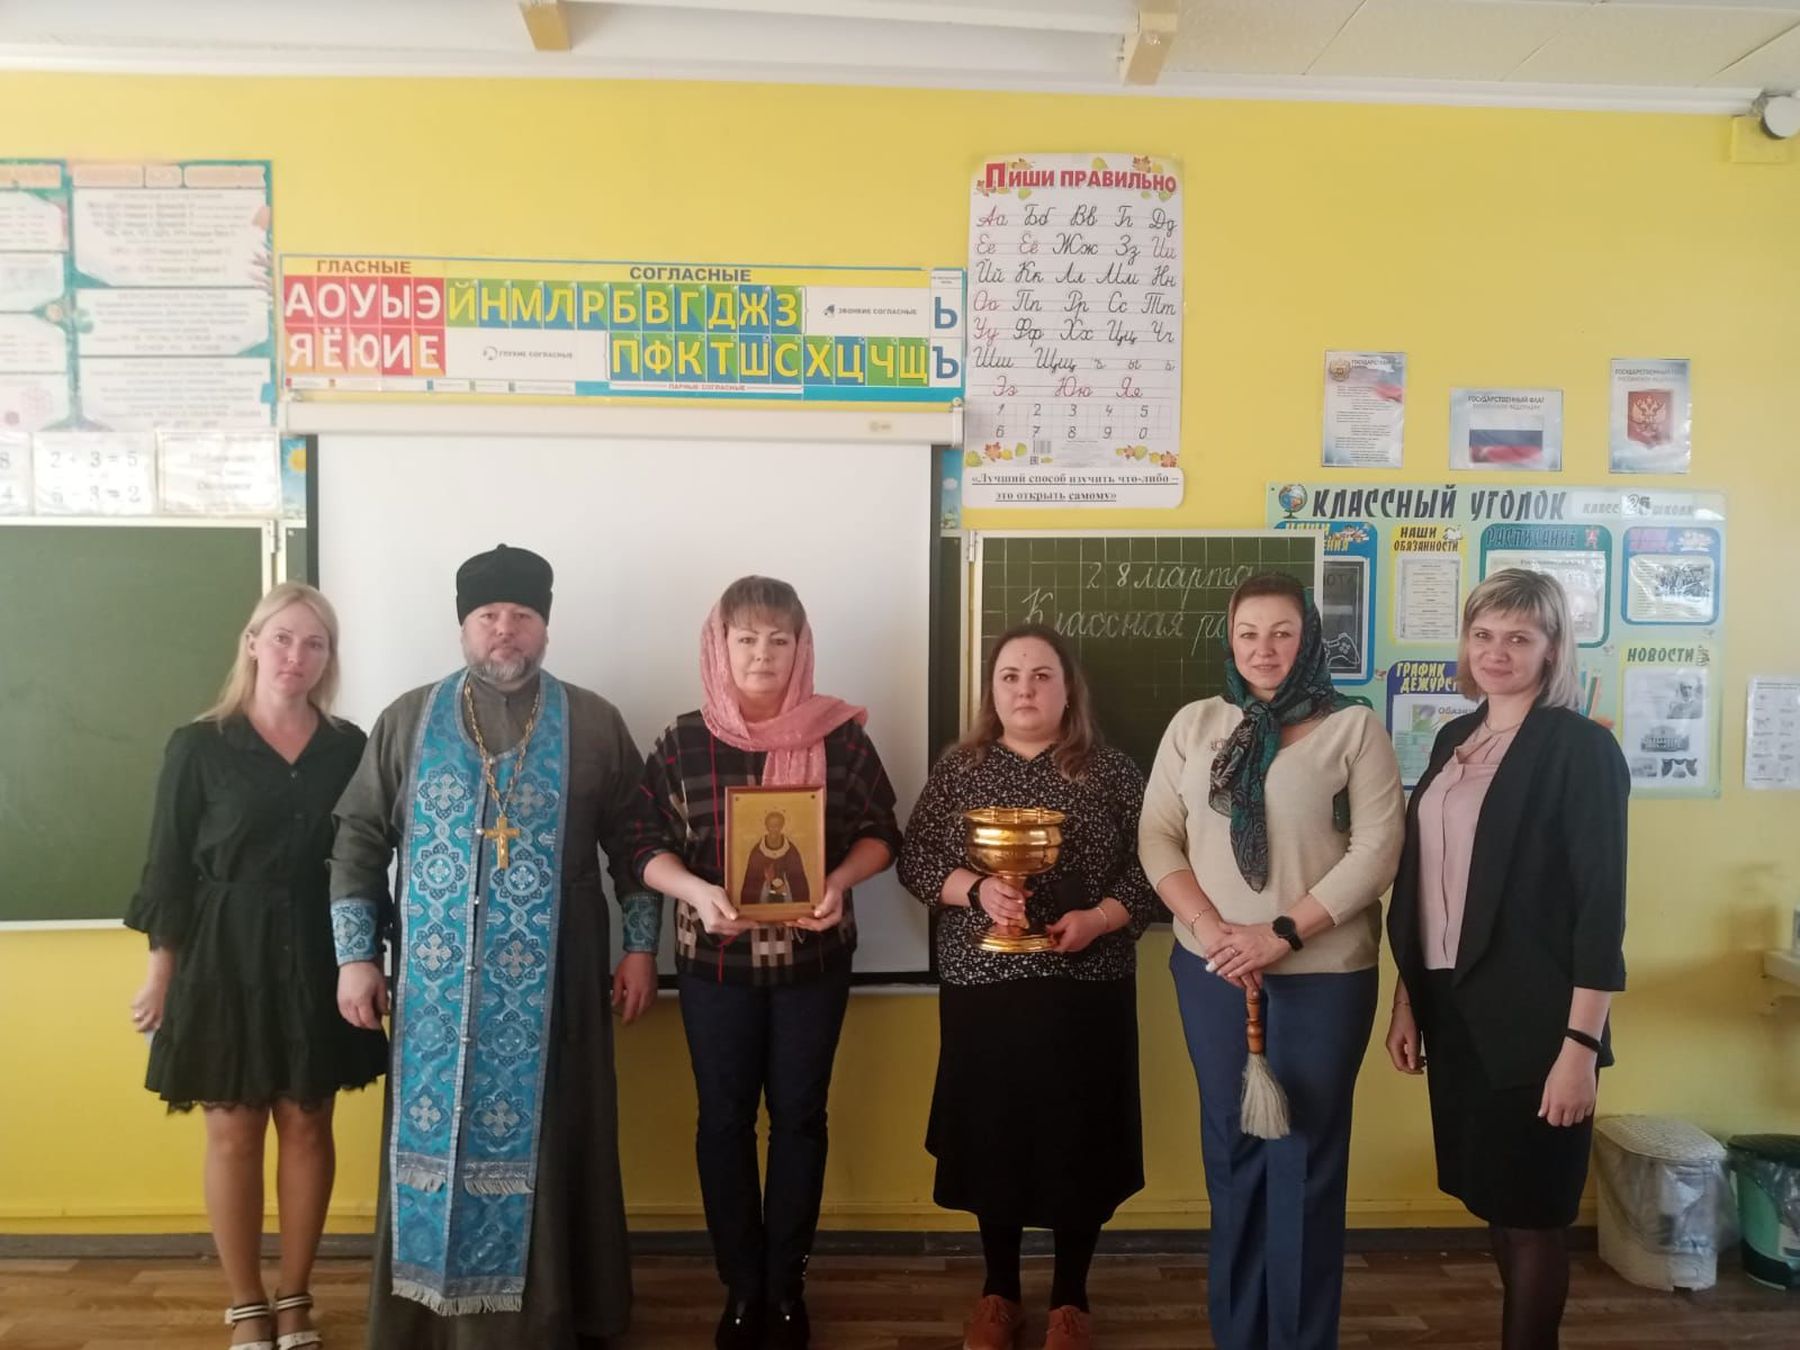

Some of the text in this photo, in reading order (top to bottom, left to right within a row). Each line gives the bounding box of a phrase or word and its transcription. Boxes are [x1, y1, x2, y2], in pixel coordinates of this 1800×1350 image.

[1060, 170, 1177, 193] ПРАВИЛЬНО
[976, 204, 1008, 227] Аа
[1024, 203, 1056, 226] Бб
[1070, 203, 1098, 227] Вв
[1148, 208, 1177, 237] Дд
[976, 233, 996, 255] Ее
[1052, 232, 1098, 256] Жж
[1115, 234, 1140, 265] Зз
[1152, 236, 1177, 260] Ии
[317, 259, 412, 275] ГЛАСНЫЕ
[630, 265, 752, 282] СОГЛАСНЫЕ
[976, 258, 1177, 287] Йй Кк Лл Мм Нн
[973, 289, 1177, 320] Оо Пп Рр Сс Тт
[973, 316, 1176, 348] Уу Фф Хх Цц Чч
[973, 346, 1014, 369] Шш
[1034, 347, 1077, 374] Щщ
[993, 375, 1144, 399] Ээ Юю Яя
[996, 402, 1150, 419] 1 2 3 4 5
[996, 425, 1148, 441] 6 7 8 9 0
[1029, 473, 1067, 484] способ
[1312, 484, 1568, 521] КЛАССНЫЙ УГОЛОК
[1400, 526, 1437, 538] НАШИ
[1486, 527, 1577, 546] РАСПИСАНИЕ
[1393, 540, 1459, 552] ОБЯЗАННОСТИ
[1627, 647, 1695, 663] НОВОСТИ
[1396, 662, 1446, 678] ГРАФИК
